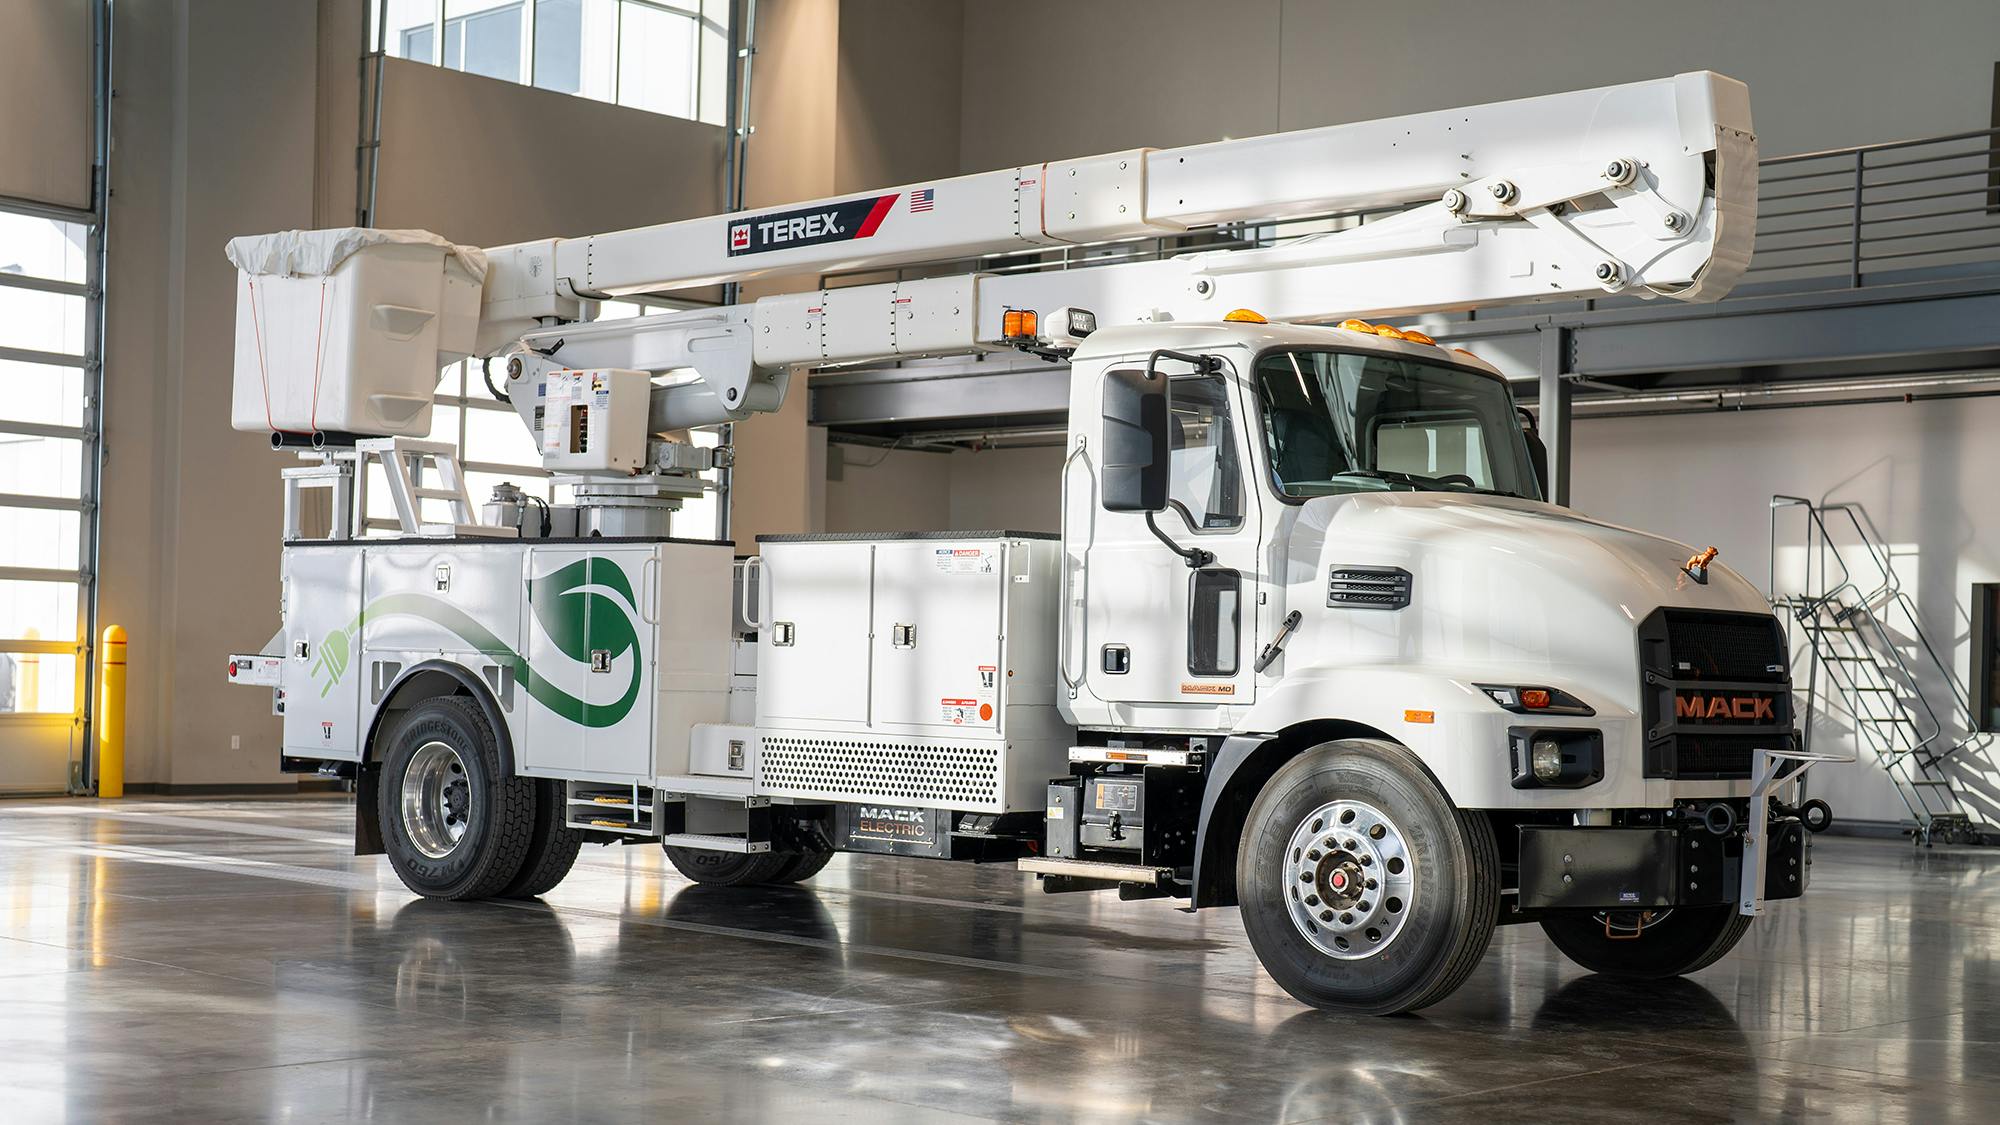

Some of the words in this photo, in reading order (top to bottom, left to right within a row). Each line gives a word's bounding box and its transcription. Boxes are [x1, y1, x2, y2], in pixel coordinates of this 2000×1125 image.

[1675, 696, 1775, 719] MACK
[860, 807, 925, 823] MACK
[860, 820, 925, 836] ELECTRIC
